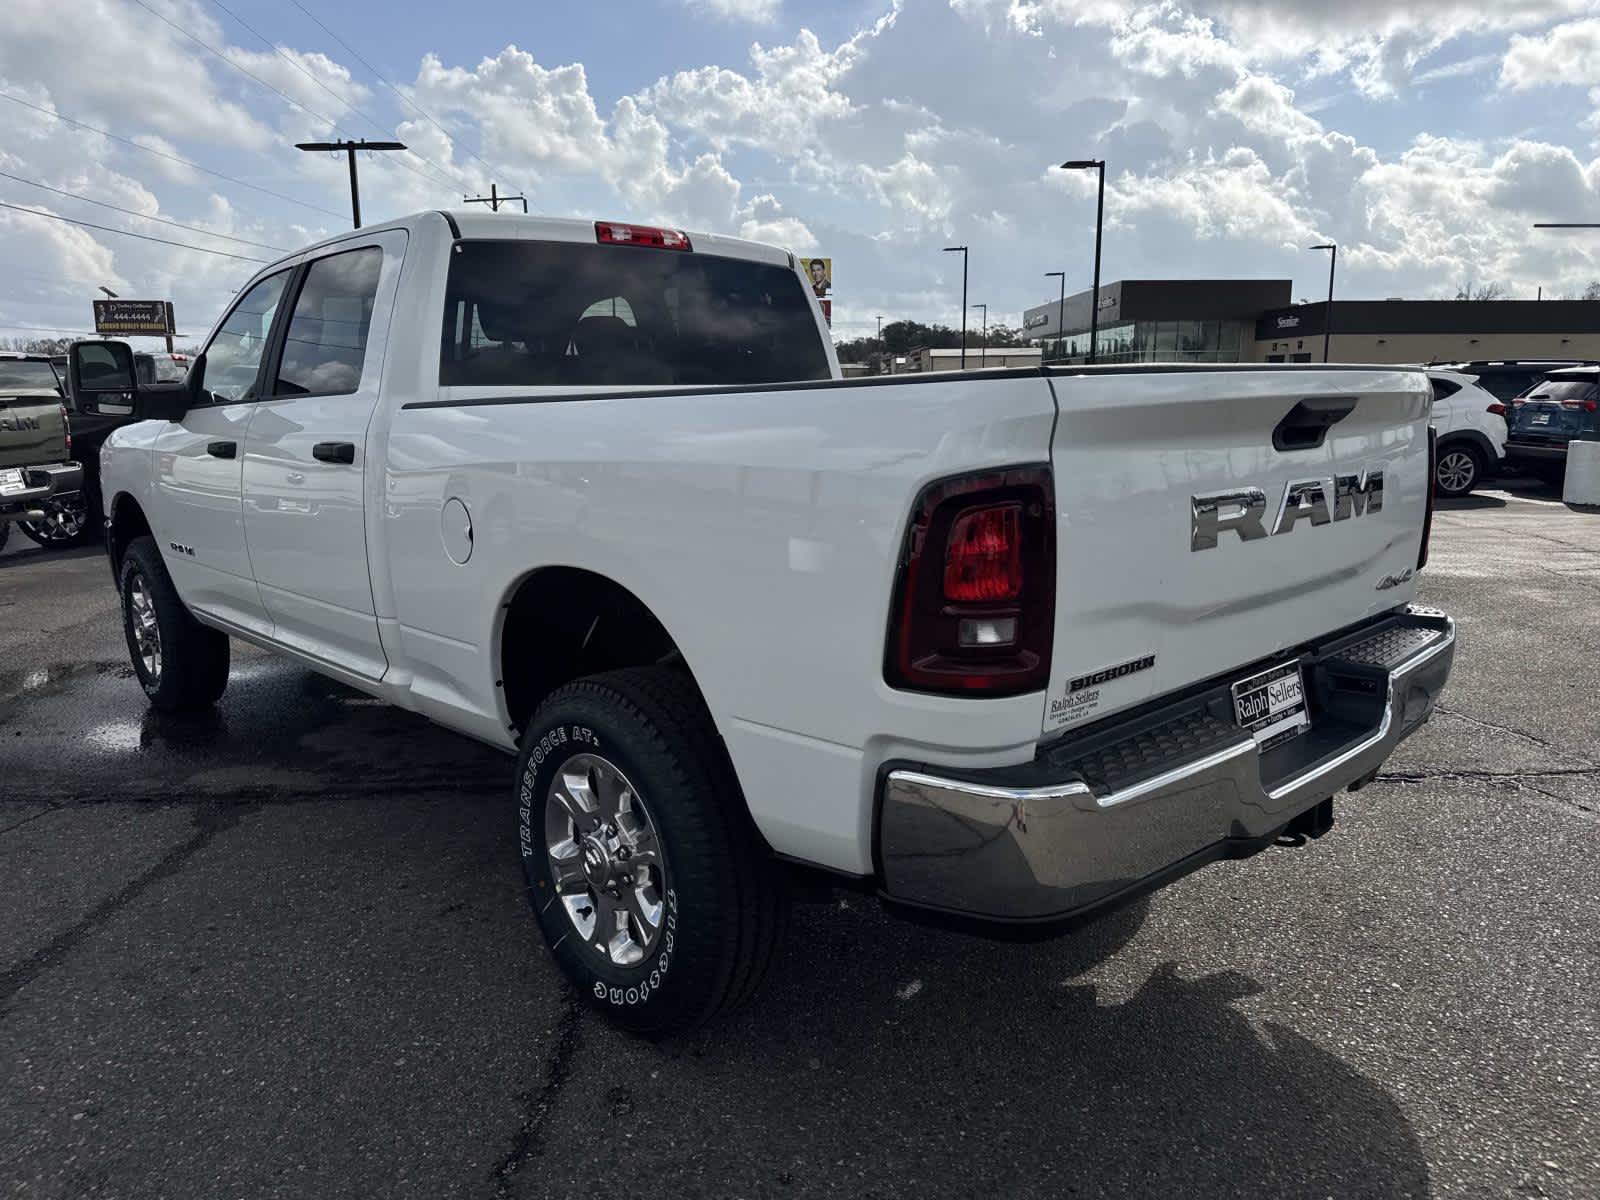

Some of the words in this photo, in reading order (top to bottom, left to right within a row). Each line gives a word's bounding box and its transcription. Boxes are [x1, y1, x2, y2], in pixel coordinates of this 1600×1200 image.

[1191, 470, 1384, 552] RAM
[1069, 655, 1156, 692] BIGHORN
[1051, 695, 1074, 712] Ralph
[1075, 689, 1100, 706] Sellers
[1237, 691, 1268, 719] Ralph
[1269, 680, 1303, 706] Sellers
[519, 727, 568, 857] TRANSFORCE
